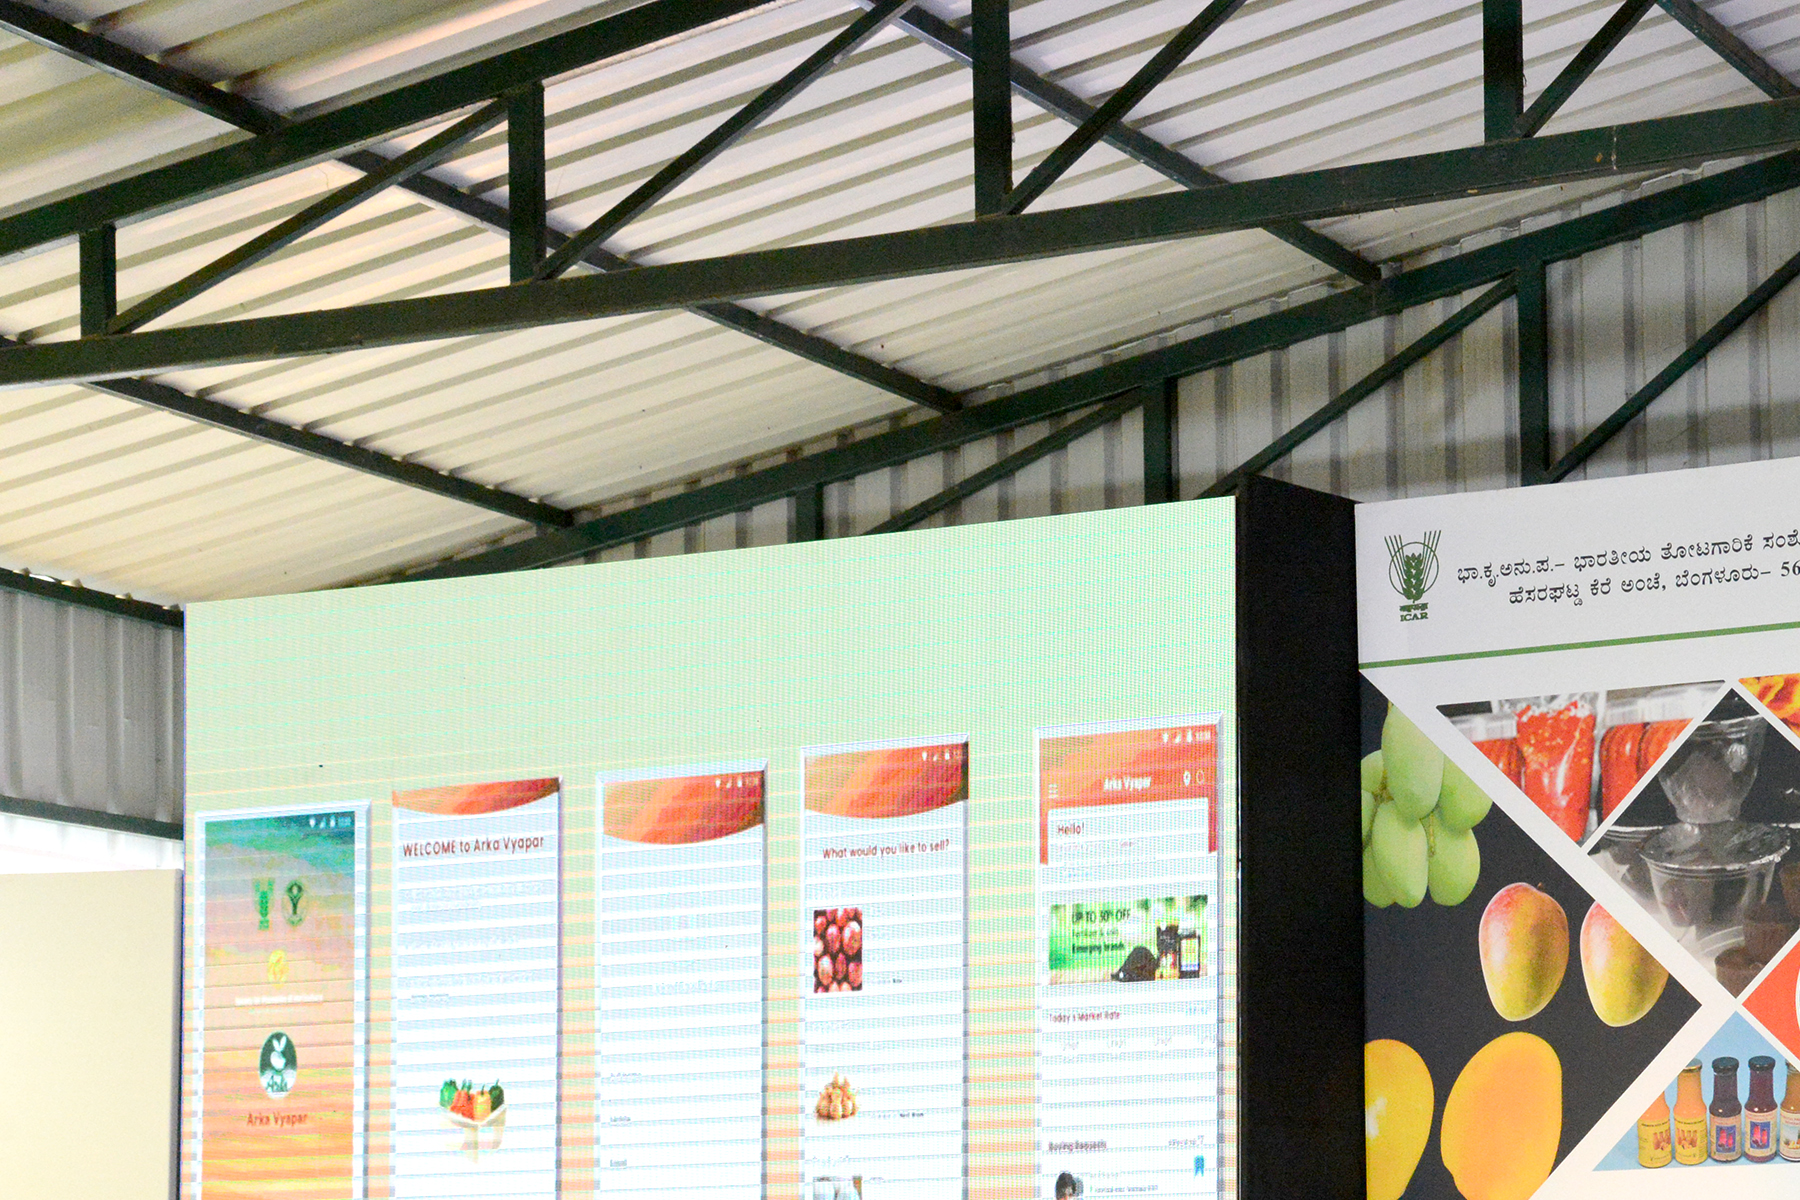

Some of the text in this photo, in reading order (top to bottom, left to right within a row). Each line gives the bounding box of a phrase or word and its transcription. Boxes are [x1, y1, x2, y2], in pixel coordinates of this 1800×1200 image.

[1574, 546, 1652, 572] ಭಾರತೀಯ
[1661, 535, 1753, 561] ತೋಟಗಾರಿಕೆ
[1508, 582, 1583, 607] ಹೆಸರಘಟ್ಟ
[1590, 577, 1612, 598] ಕೆರೆ
[1620, 572, 1666, 595] ಅಂಚೆ,
[1399, 612, 1429, 622] ICAR
[403, 835, 545, 857] WELCOME to Arka Vyapar
[822, 846, 847, 860] What
[850, 844, 878, 857] would
[880, 845, 897, 859] you
[899, 841, 915, 854] like
[918, 841, 927, 852] to
